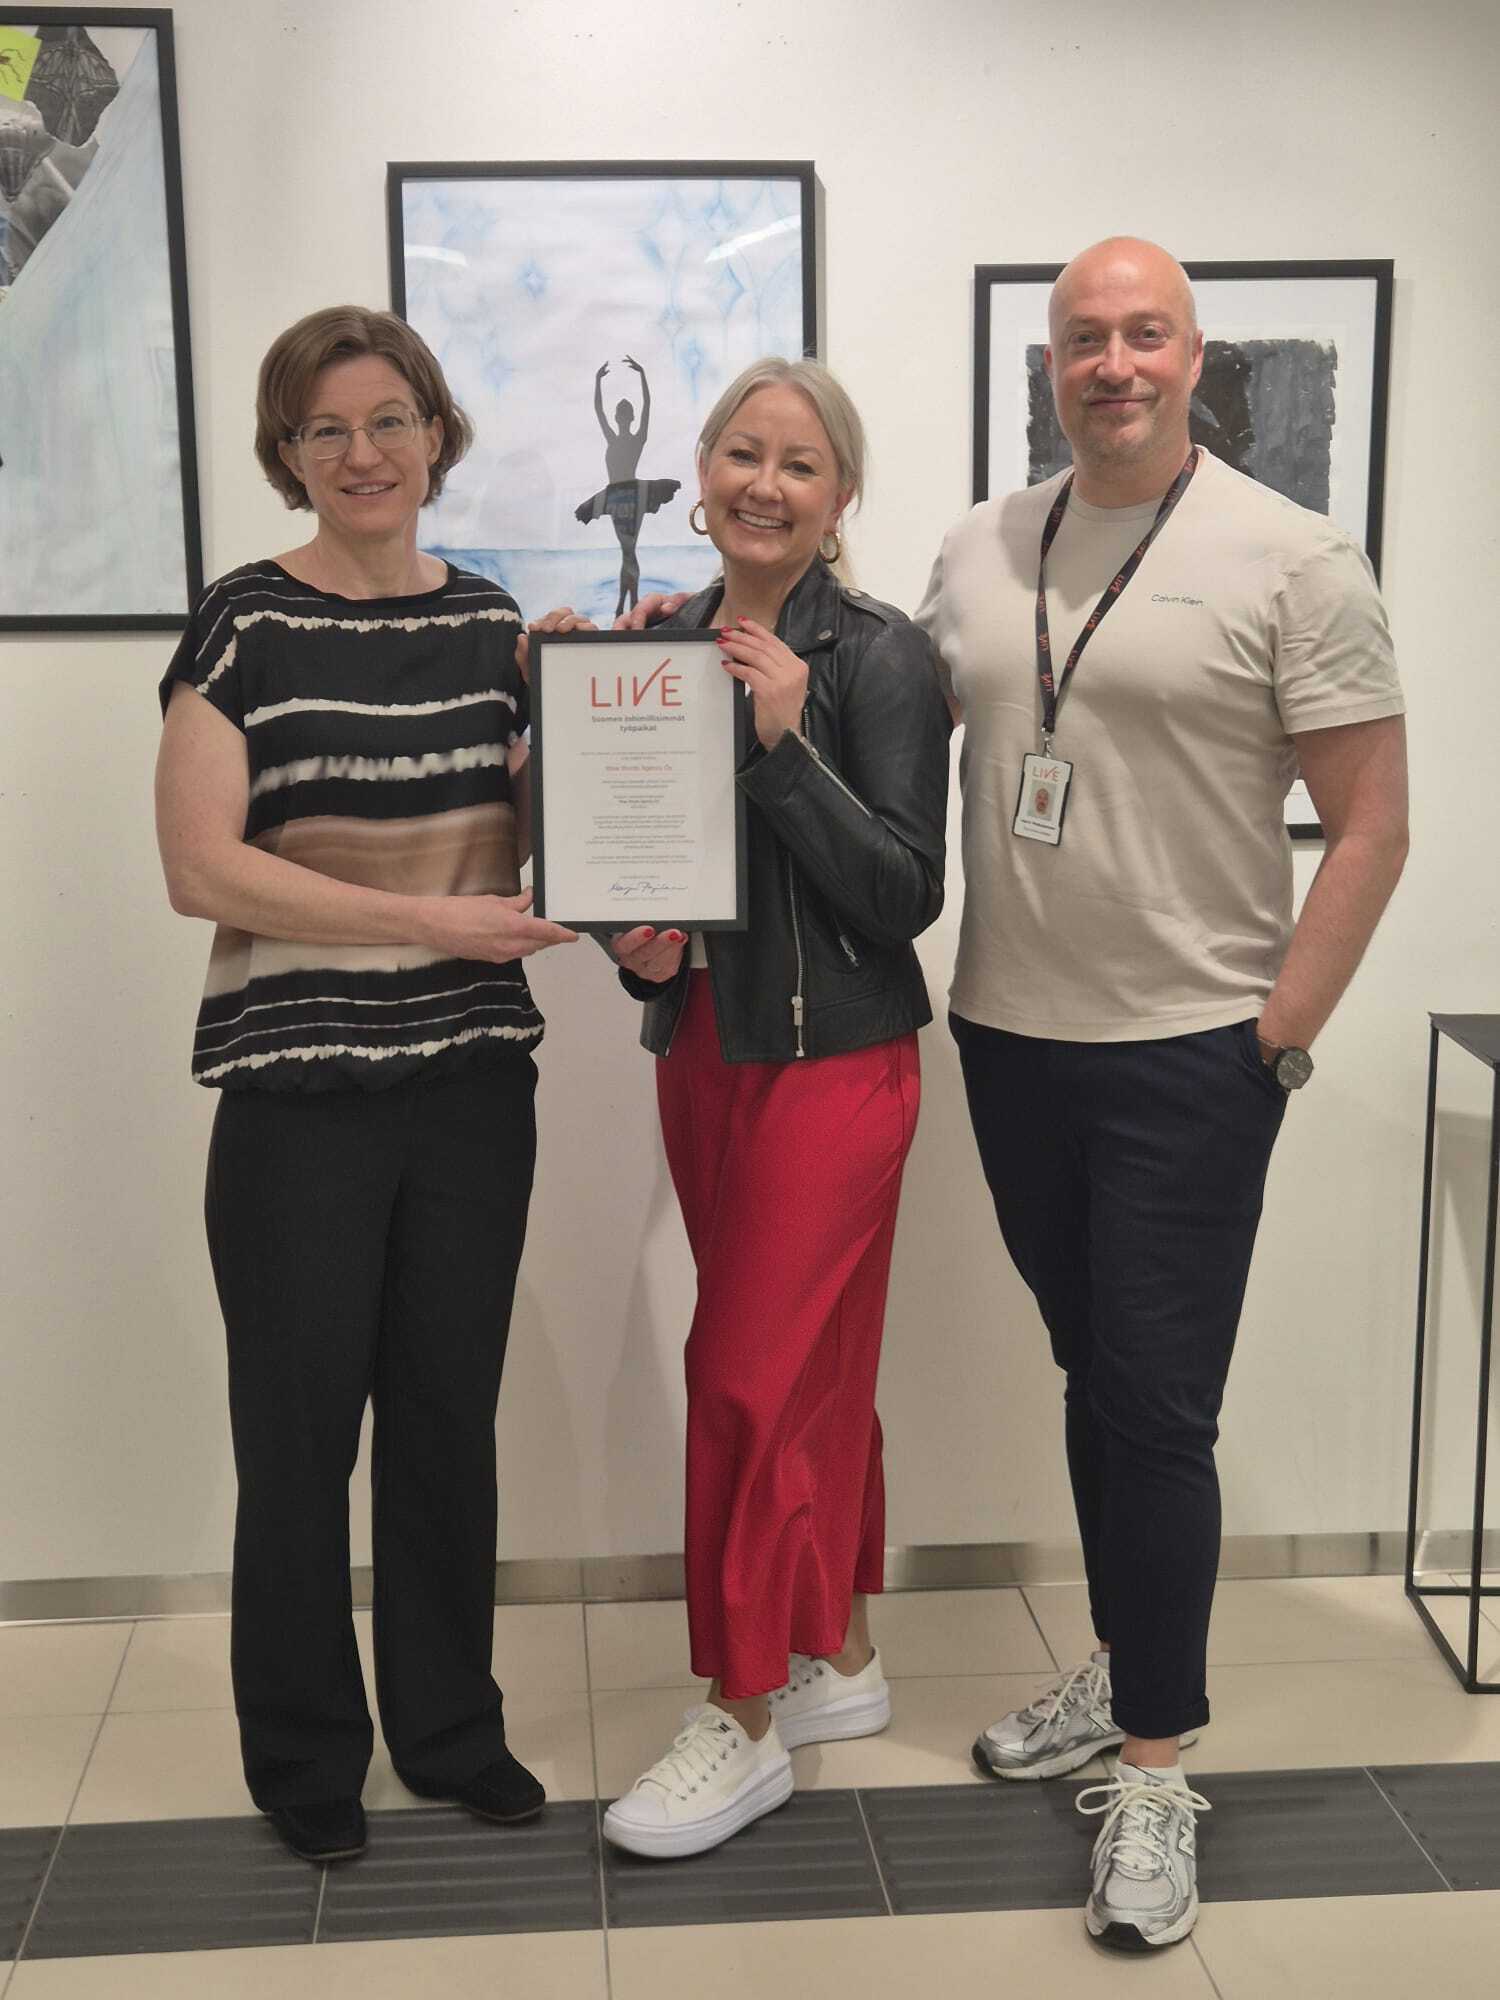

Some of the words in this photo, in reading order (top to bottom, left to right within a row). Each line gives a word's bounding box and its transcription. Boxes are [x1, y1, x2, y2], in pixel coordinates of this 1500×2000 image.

[1109, 575, 1125, 593] LIVE
[1151, 594, 1179, 603] Calvin
[1180, 596, 1204, 606] Klein
[592, 658, 682, 707] LIVE
[1040, 672, 1054, 694] LIVE
[1032, 765, 1061, 782] LIVE
